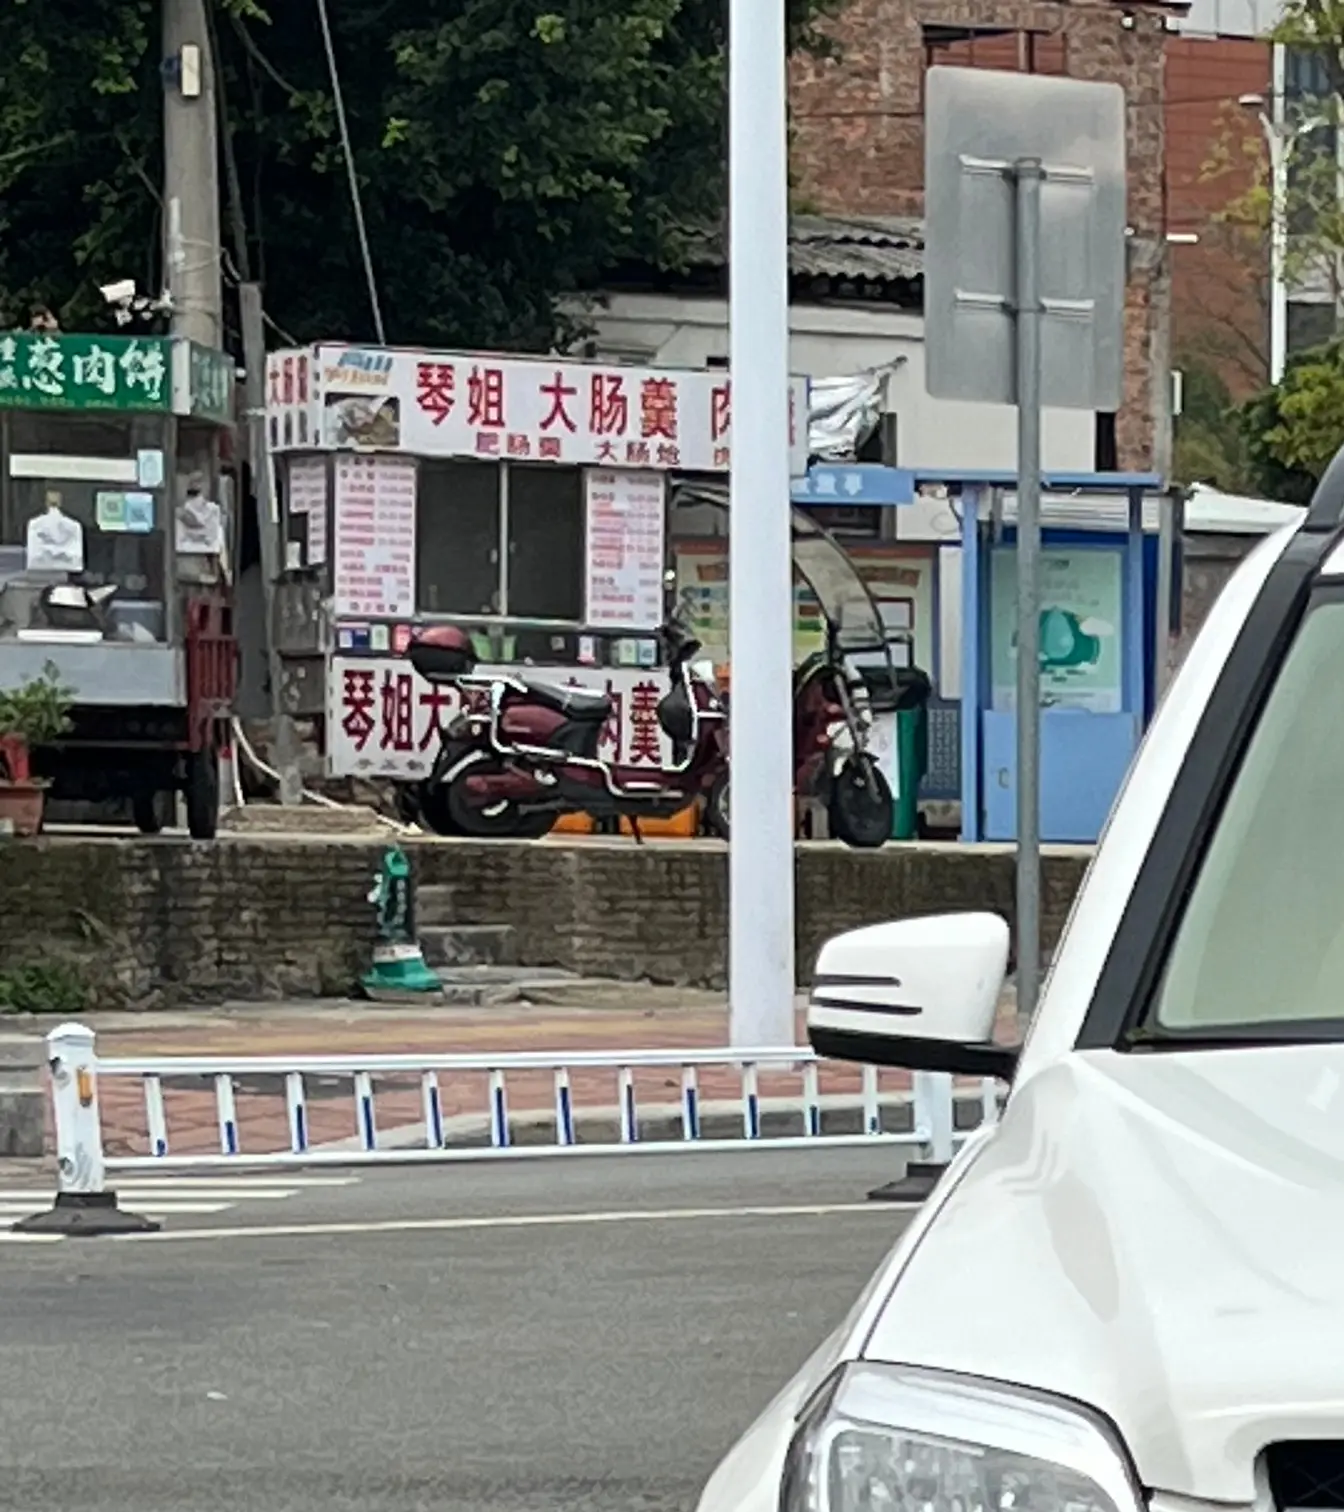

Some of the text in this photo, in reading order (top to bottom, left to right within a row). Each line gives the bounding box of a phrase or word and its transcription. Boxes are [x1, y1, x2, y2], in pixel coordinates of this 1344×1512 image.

[416, 361, 505, 429] 琴姐
[539, 371, 678, 440] 大肠羹
